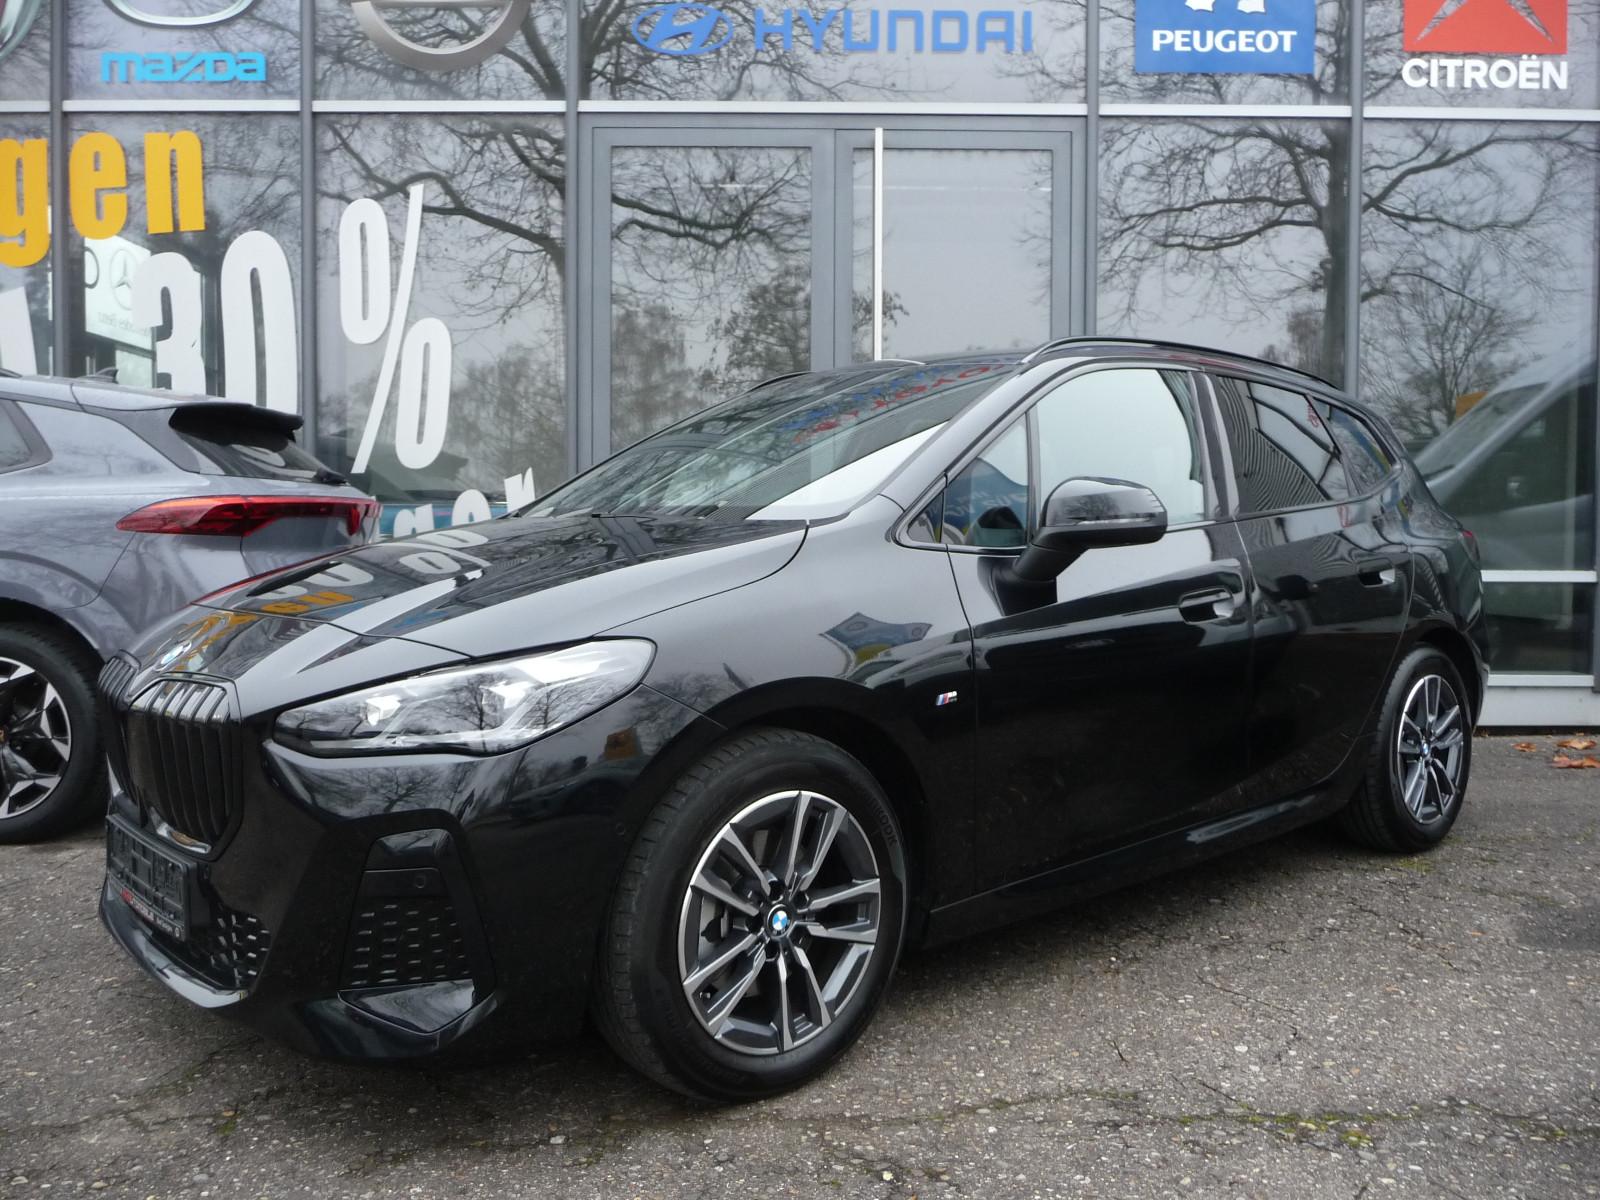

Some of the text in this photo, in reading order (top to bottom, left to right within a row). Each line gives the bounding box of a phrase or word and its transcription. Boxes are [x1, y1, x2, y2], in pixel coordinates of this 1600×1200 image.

[754, 9, 1033, 53] HYUNDAI
[1151, 29, 1298, 53] PEUGEOT
[1401, 54, 1568, 90] CITROËN
[0, 129, 206, 268] gen
